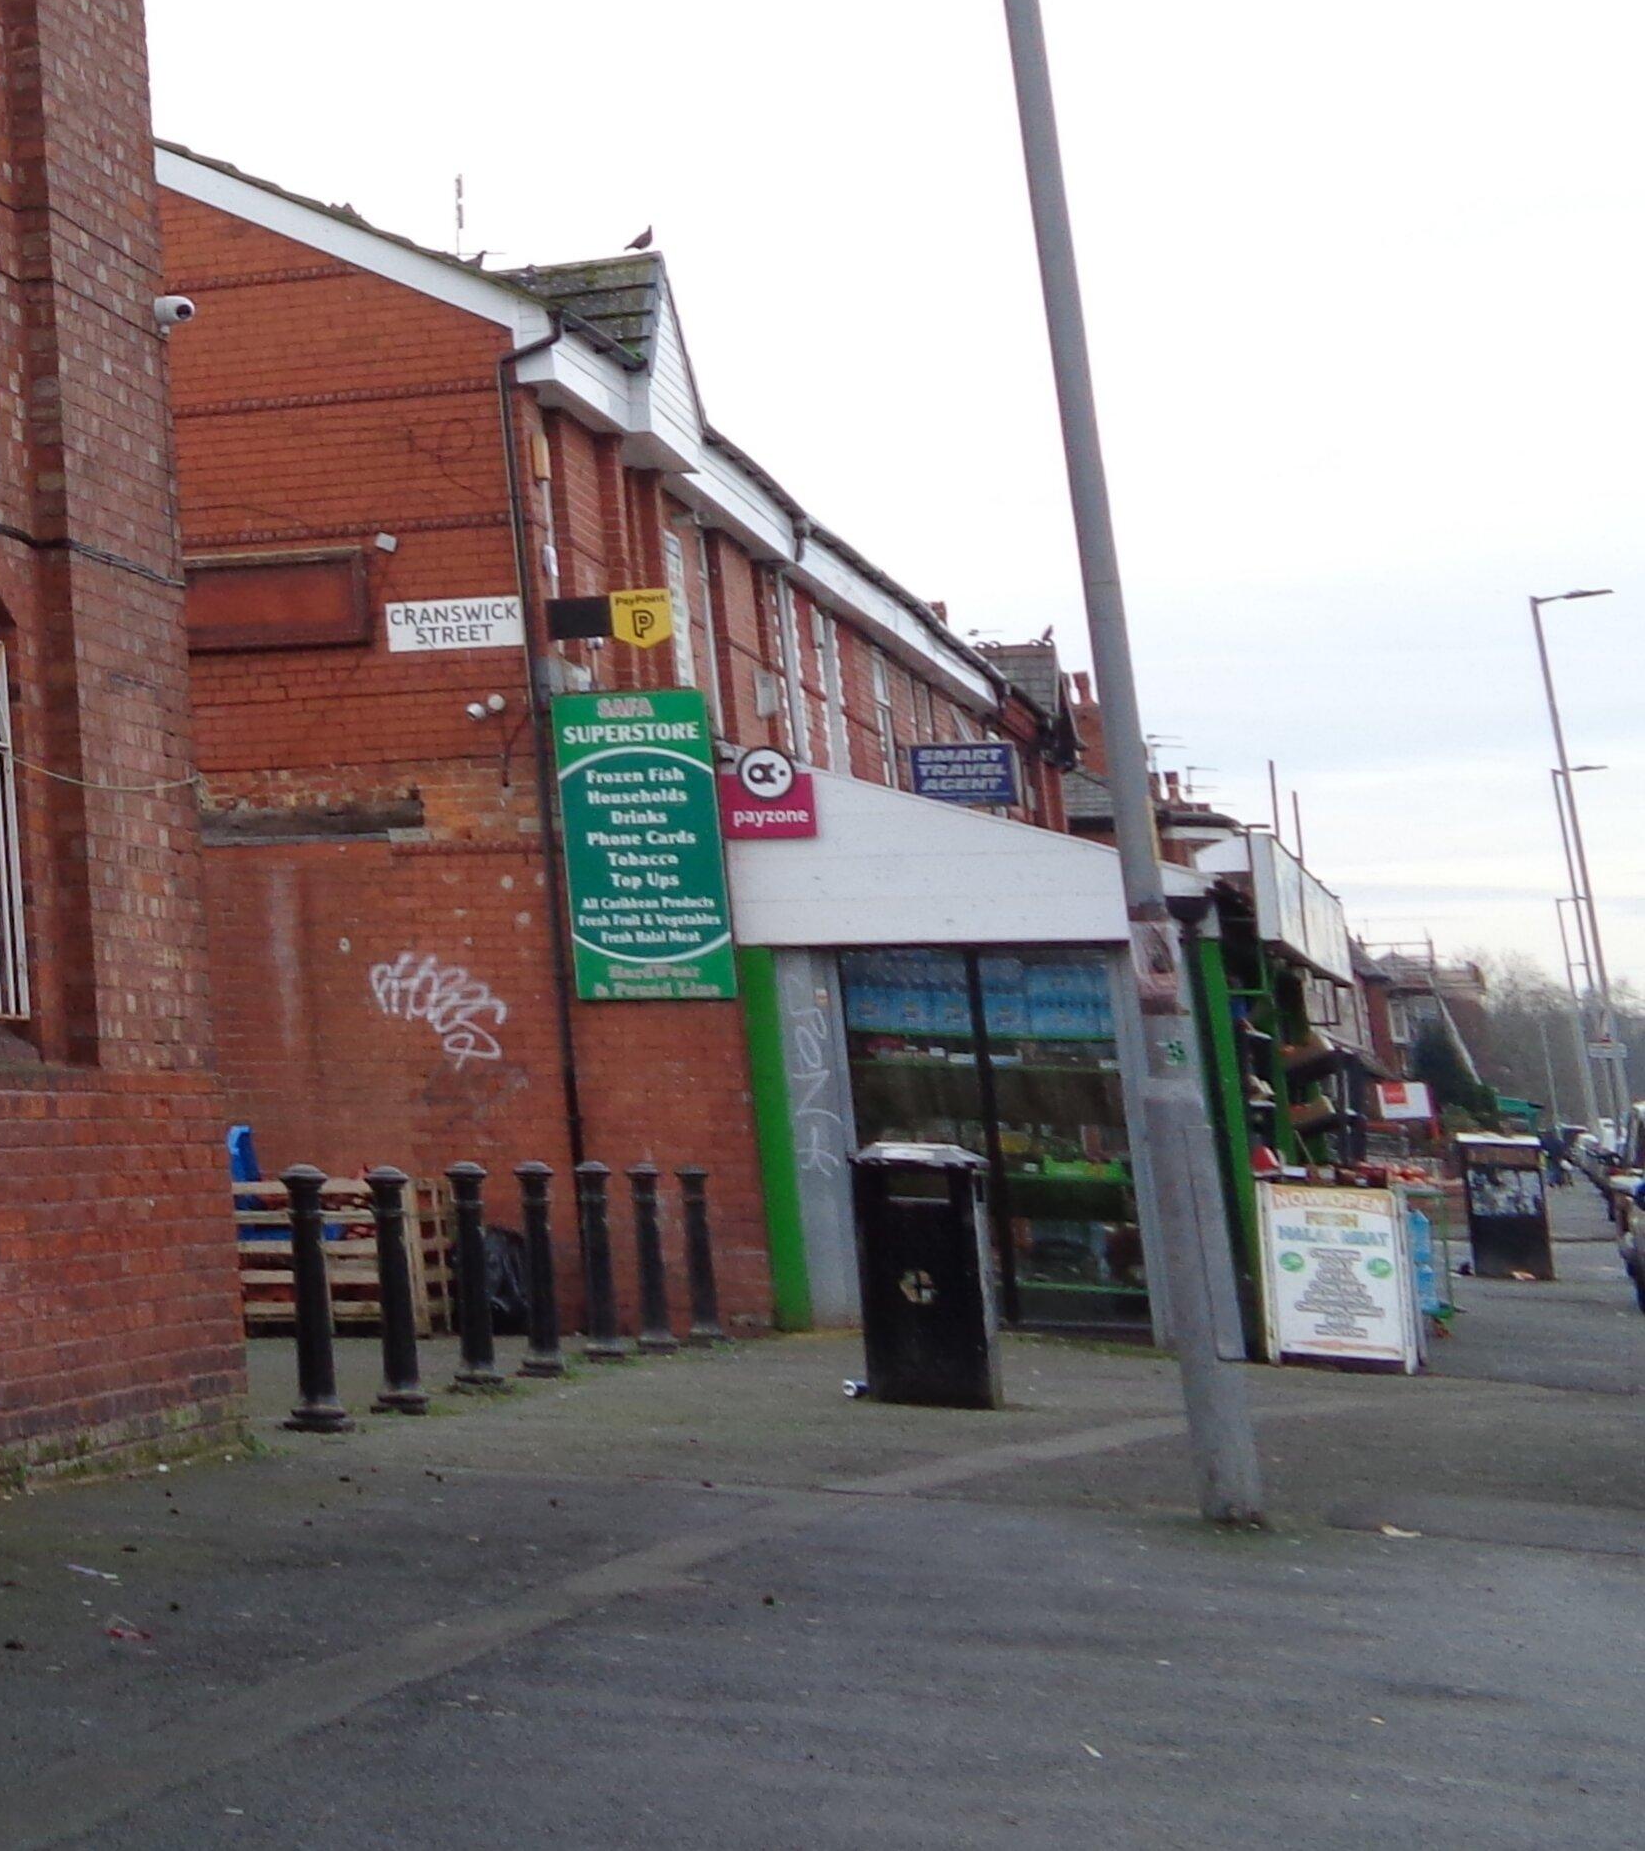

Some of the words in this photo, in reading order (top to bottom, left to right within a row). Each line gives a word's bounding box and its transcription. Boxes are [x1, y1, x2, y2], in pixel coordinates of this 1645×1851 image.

[615, 595, 666, 607] PayPoint
[390, 603, 518, 626] CRANSWICK
[416, 623, 493, 645] STREET
[597, 697, 655, 719] SAFA
[563, 721, 700, 744] SUPERSTORE
[918, 748, 1003, 762] SMART
[586, 769, 644, 784] Frozen
[648, 767, 685, 782] Fish
[918, 763, 1007, 777] TRAVEL
[921, 777, 1003, 791] AGENT
[587, 788, 688, 804] Households
[611, 809, 668, 825] Drinks
[733, 809, 810, 828] payzone
[587, 831, 642, 846] Phone
[646, 830, 696, 845] Cards
[607, 852, 679, 867] Tobacco
[610, 873, 643, 890] Top
[646, 872, 680, 890] Ups
[661, 896, 715, 908] Products
[578, 915, 610, 926] Fresh
[612, 914, 641, 926] Fruit
[655, 913, 721, 928] Vegetables
[601, 931, 633, 944] Fresh
[669, 930, 701, 943] Meat
